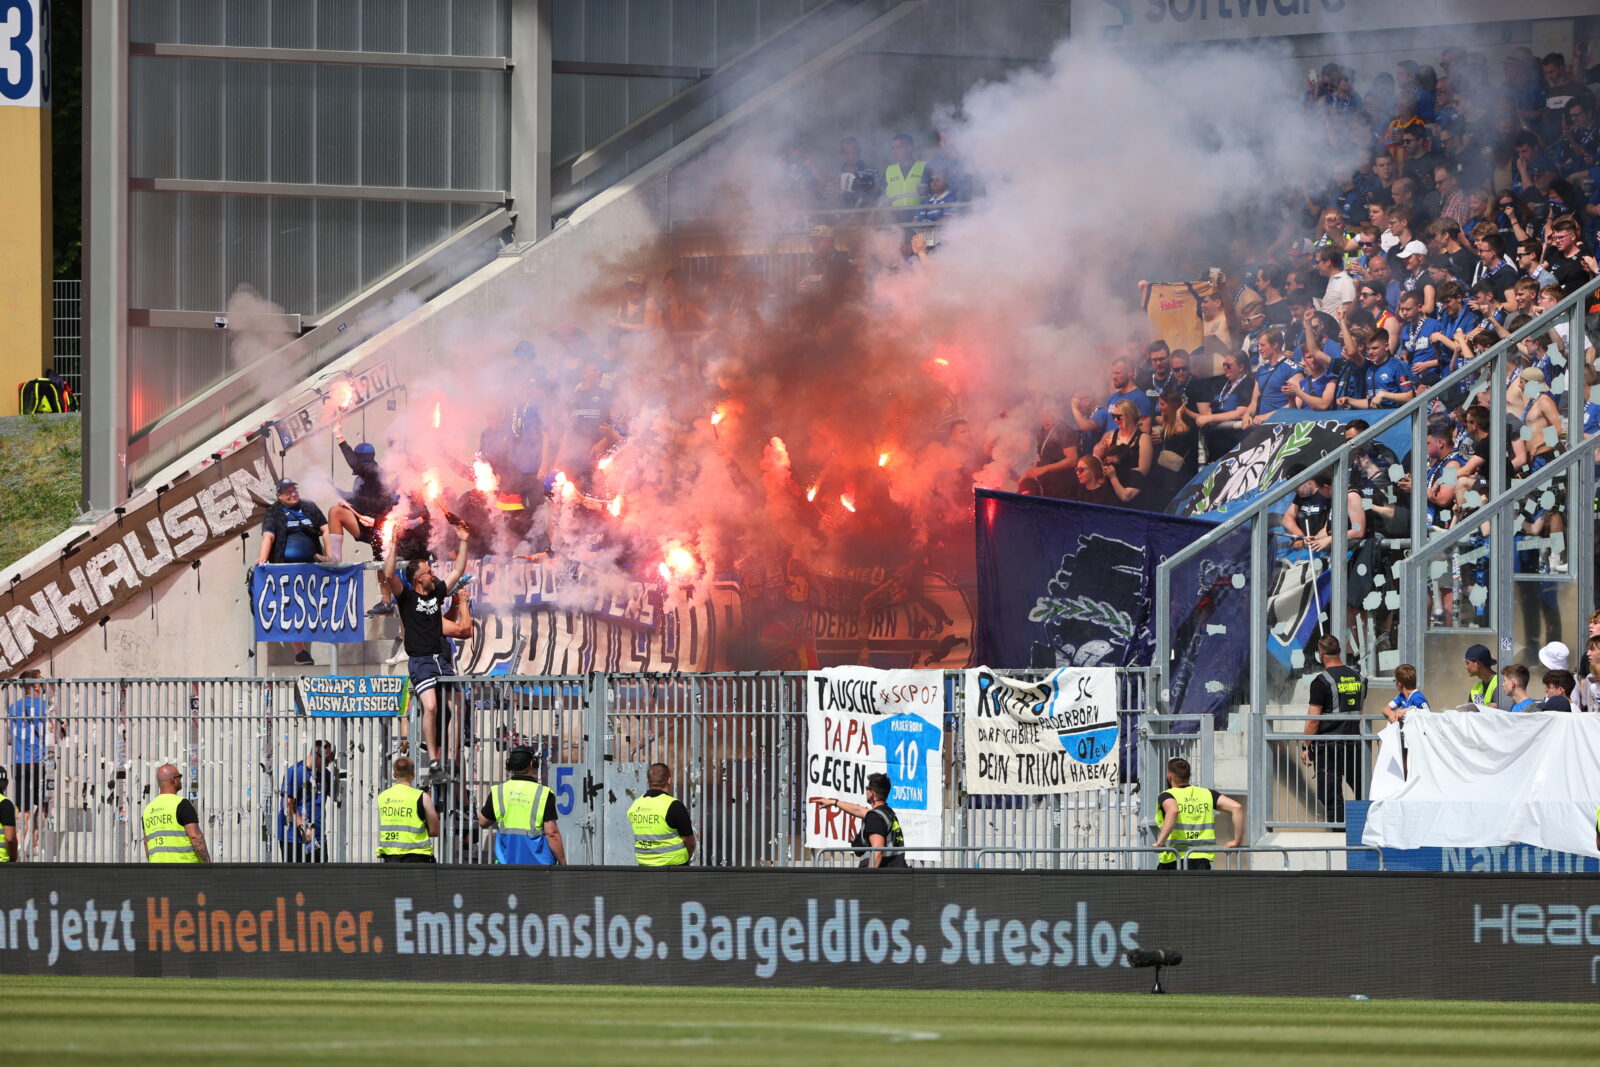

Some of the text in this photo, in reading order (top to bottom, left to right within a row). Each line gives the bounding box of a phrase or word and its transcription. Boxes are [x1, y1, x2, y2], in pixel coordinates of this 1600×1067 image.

[0, 0, 33, 100] 3
[0, 456, 278, 677] INHAUSEN
[258, 573, 358, 633] GESSELN
[303, 677, 402, 694] SCHNAPS & WEED
[308, 695, 400, 713] AUSWÄRTSSIEG!
[814, 676, 882, 716] TAUSCHE
[1074, 675, 1093, 702] SC
[824, 716, 870, 756] PAPA
[978, 728, 1000, 742] DARF
[1038, 704, 1099, 731] PADERBORN
[894, 739, 919, 781] 10
[1077, 736, 1096, 760] 07
[809, 753, 867, 796] GEGEN
[978, 752, 1010, 785] DEIN
[1016, 750, 1067, 787] TRIKOT
[556, 766, 575, 816] 5
[381, 806, 413, 818] RDNER
[631, 814, 660, 825] RDNER
[809, 796, 864, 844] TRIK
[48, 890, 136, 967] jetzt
[147, 891, 384, 954] HeinerLiner.
[395, 893, 669, 960] Emissionslos.
[681, 898, 928, 979] Bargeldlos.
[940, 901, 1141, 968] Stresslos
